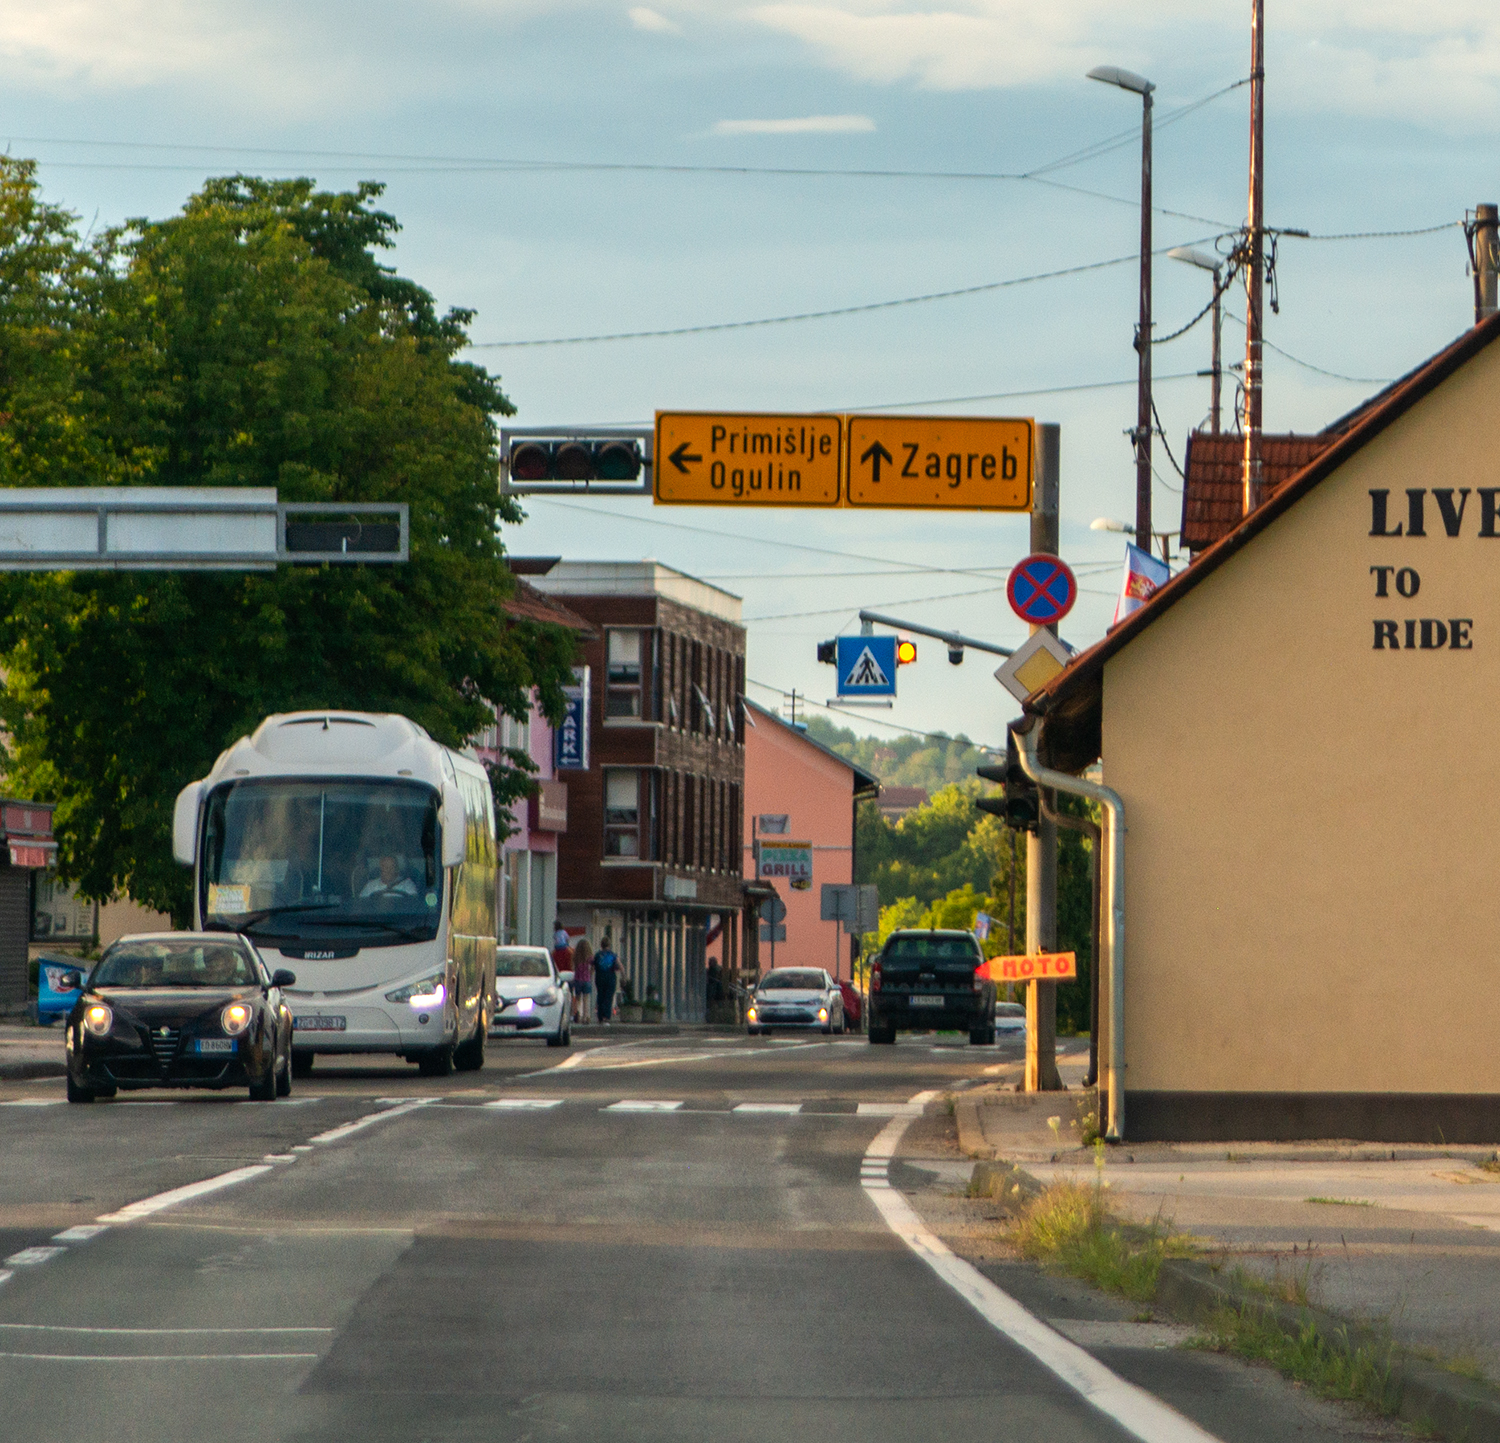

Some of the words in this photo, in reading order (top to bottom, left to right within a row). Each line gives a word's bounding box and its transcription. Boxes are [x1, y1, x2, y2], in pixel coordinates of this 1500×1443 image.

[710, 424, 832, 462] Primišlje
[710, 461, 801, 498] Ogulin
[901, 442, 1018, 488] Zagreb
[1369, 565, 1421, 598] TO
[1372, 619, 1474, 650] RIDE
[563, 701, 577, 755] PARK
[762, 863, 809, 876] GRILL
[304, 950, 335, 959] IRIZAR
[1002, 956, 1070, 978] MOTO
